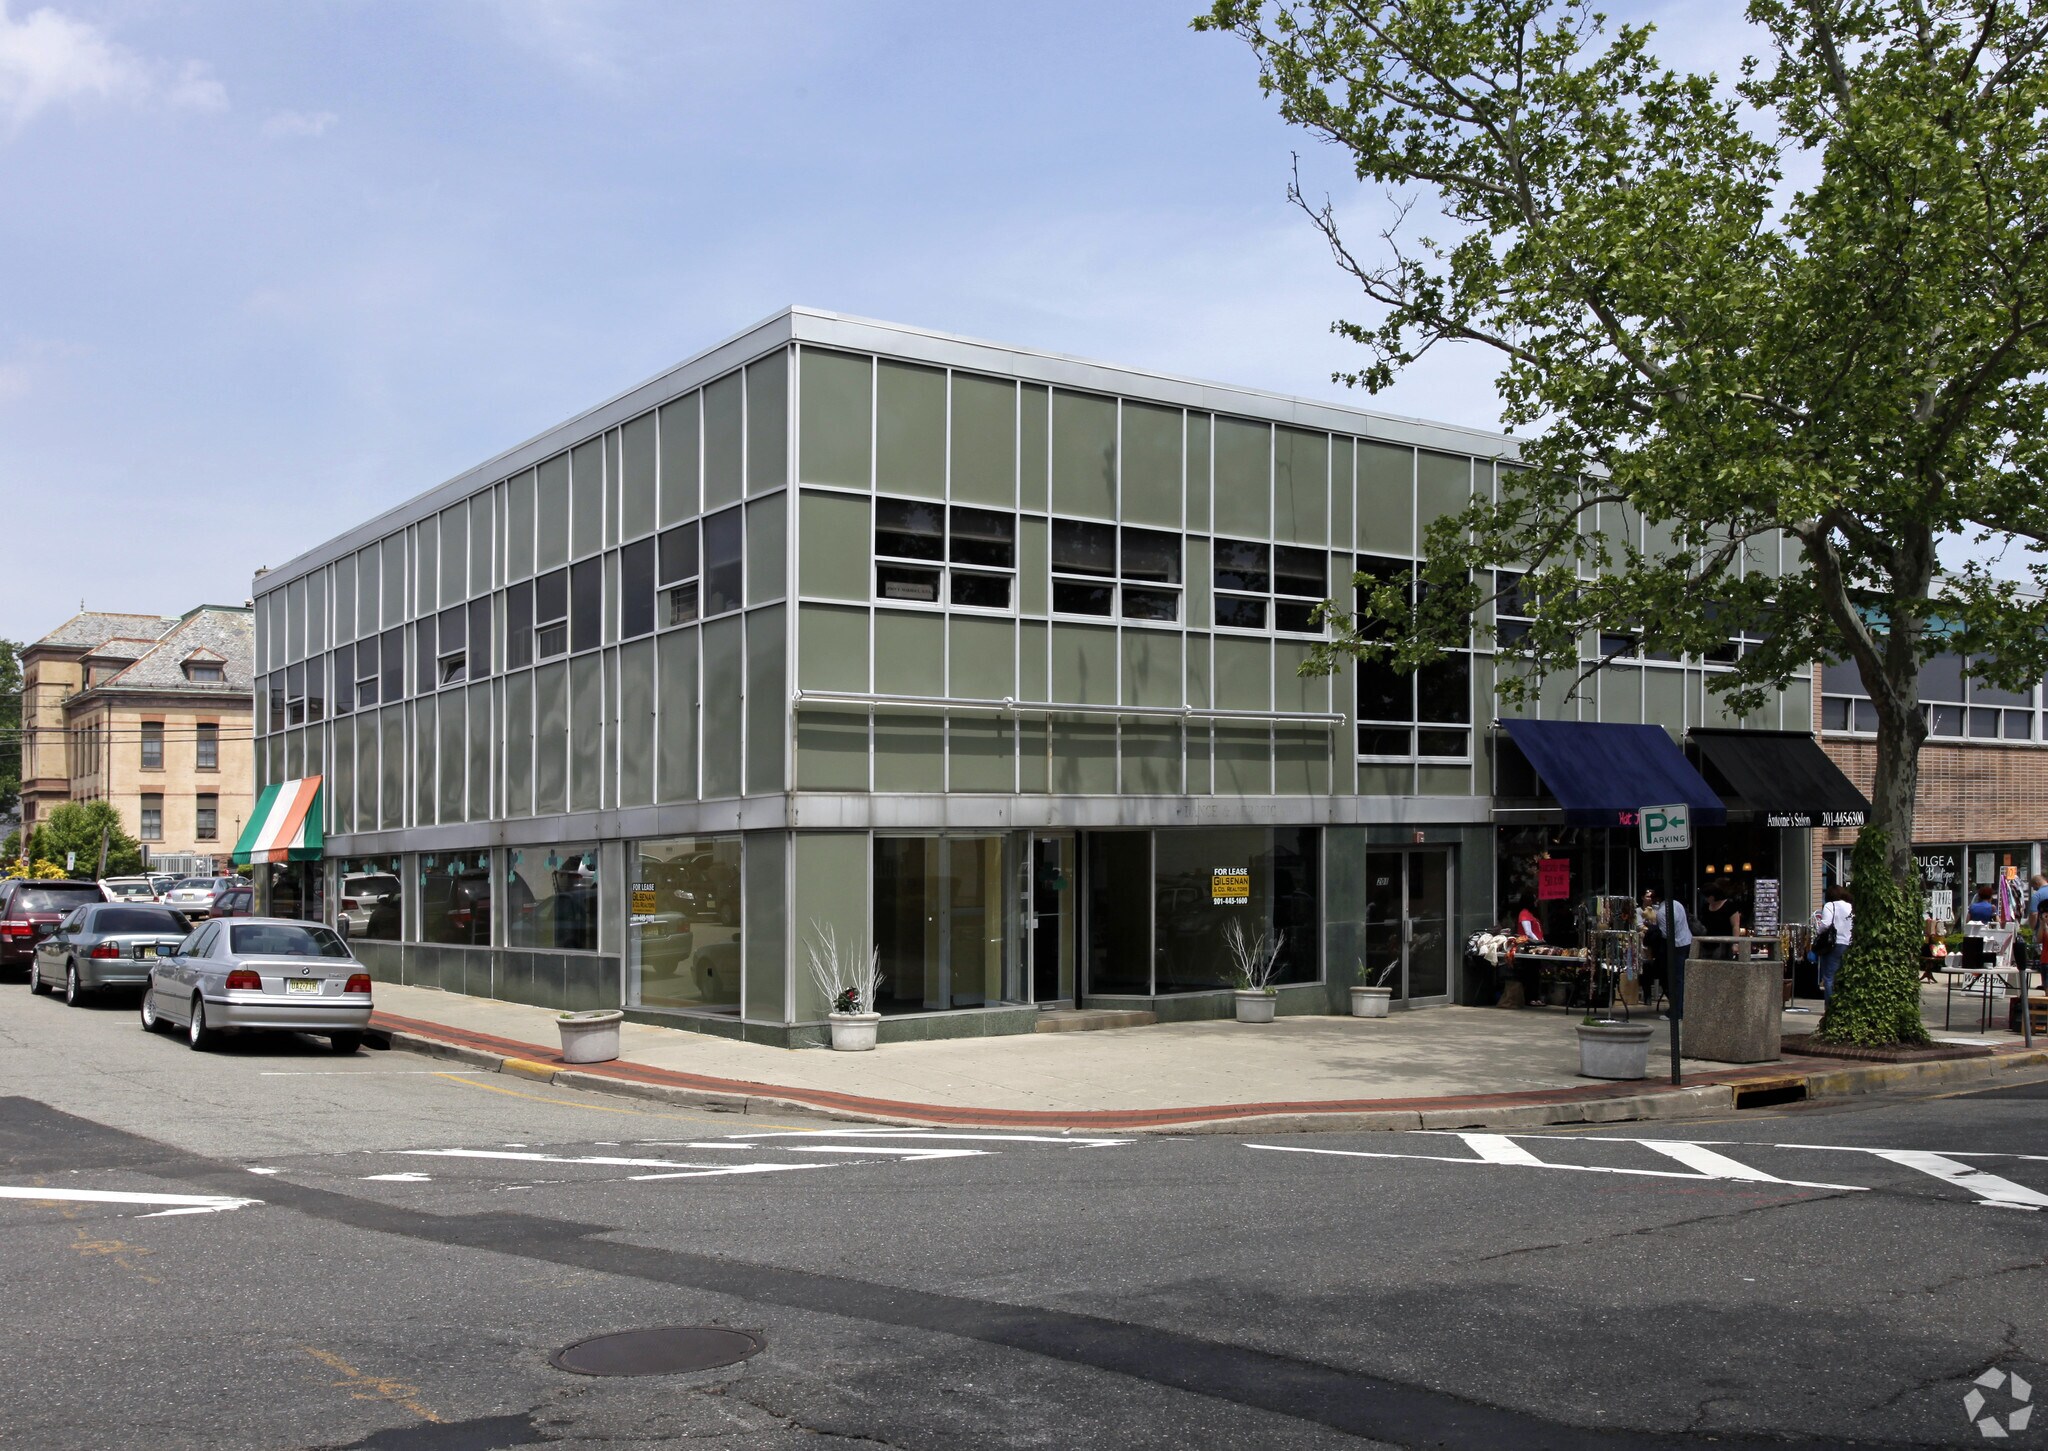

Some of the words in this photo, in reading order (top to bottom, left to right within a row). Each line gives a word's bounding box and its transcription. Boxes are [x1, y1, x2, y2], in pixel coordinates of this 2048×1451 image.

[1767, 812, 1794, 826] Antoine's
[1795, 812, 1811, 826] Salon
[1822, 811, 1864, 826] 201-445-6300
[1946, 855, 1955, 866] A
[1214, 868, 1228, 876] FOR
[1228, 867, 1248, 875] LEASE
[1213, 876, 1248, 886] GILSENAN
